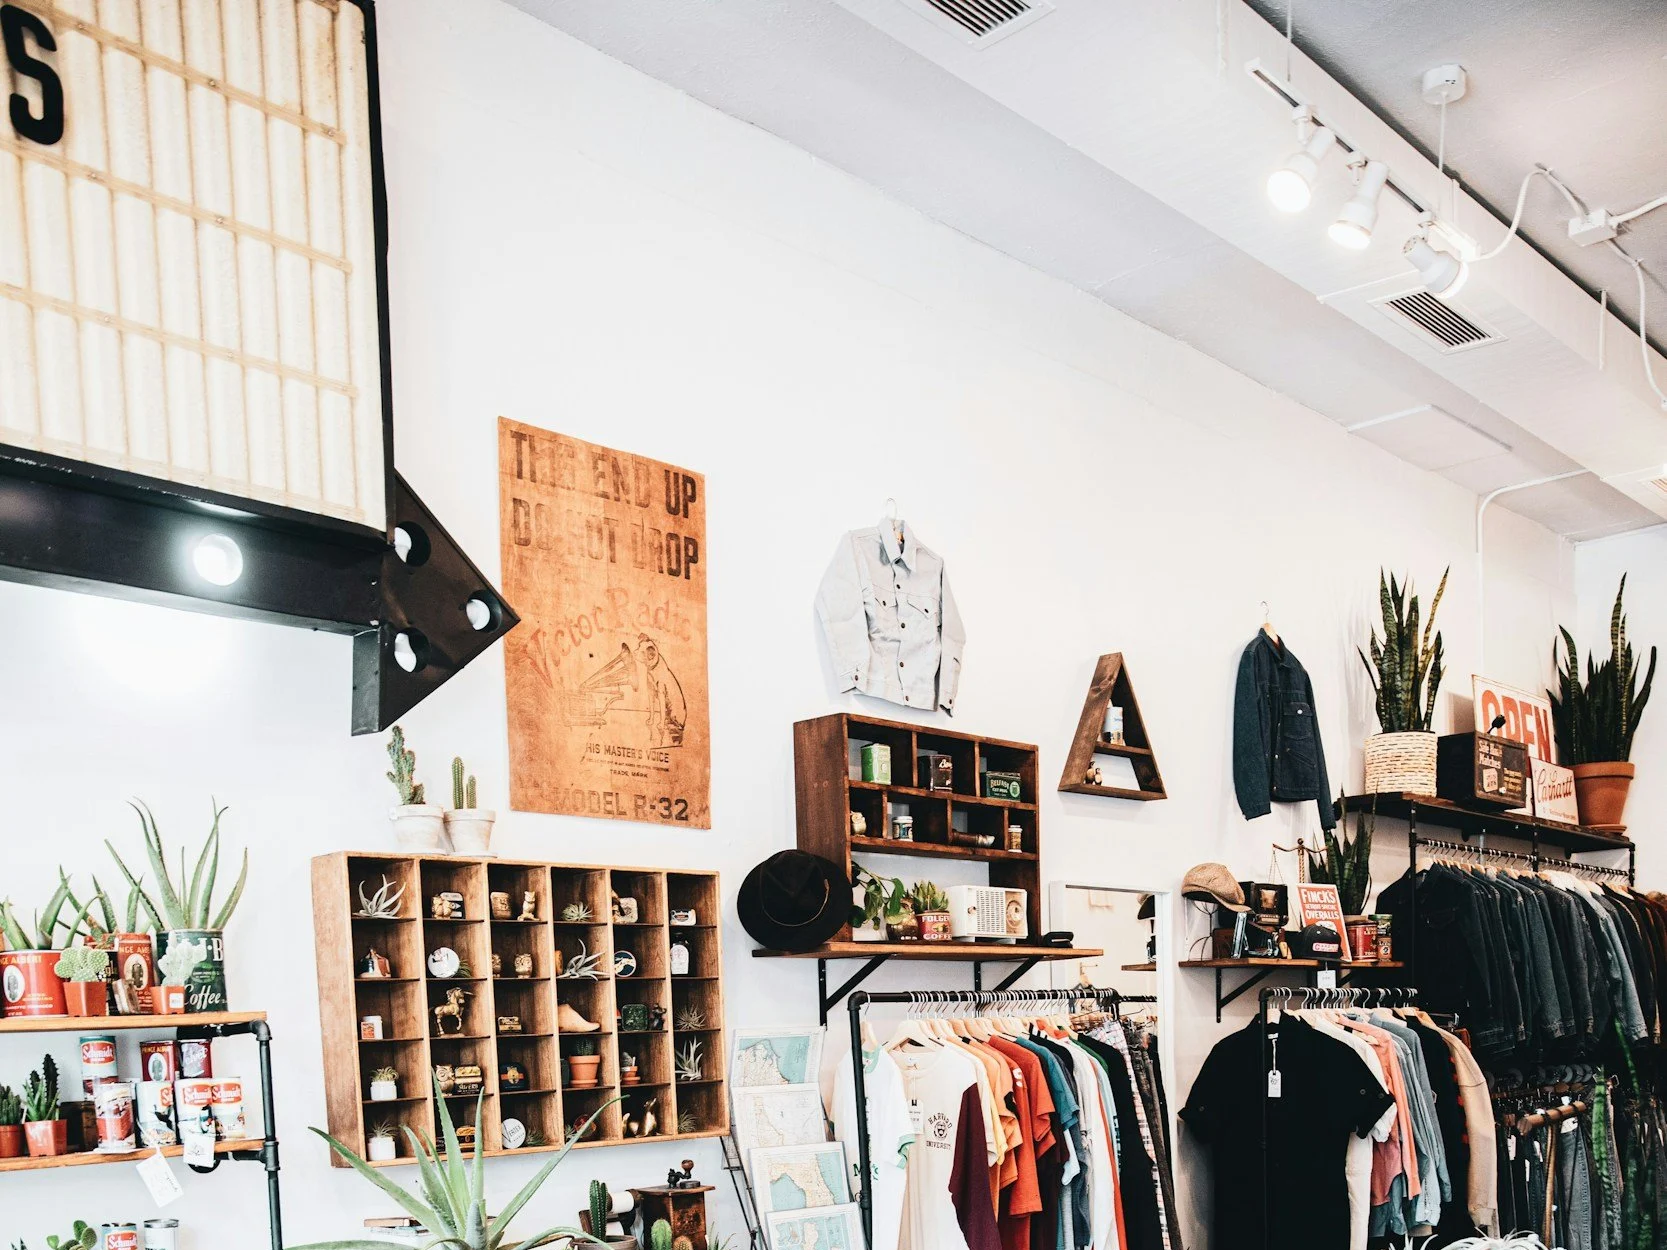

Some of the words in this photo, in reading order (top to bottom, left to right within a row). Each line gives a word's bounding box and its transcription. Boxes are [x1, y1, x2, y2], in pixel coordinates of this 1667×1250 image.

[0, 4, 64, 145] S
[592, 451, 651, 508] END
[664, 469, 697, 519] UP
[513, 497, 552, 550] DO
[630, 522, 699, 580] DROP
[523, 605, 604, 689] Victor
[605, 586, 692, 642] Radio
[1481, 689, 1552, 764] OPEN
[585, 743, 600, 754] HIS
[604, 745, 642, 760] MASTER'S
[645, 749, 670, 763] VOICE
[550, 787, 627, 816] MODEL
[634, 794, 689, 822] R-32
[1301, 889, 1336, 904] FINCK'S
[1305, 910, 1340, 920] OVERALLS
[184, 983, 221, 1010] Coffee
